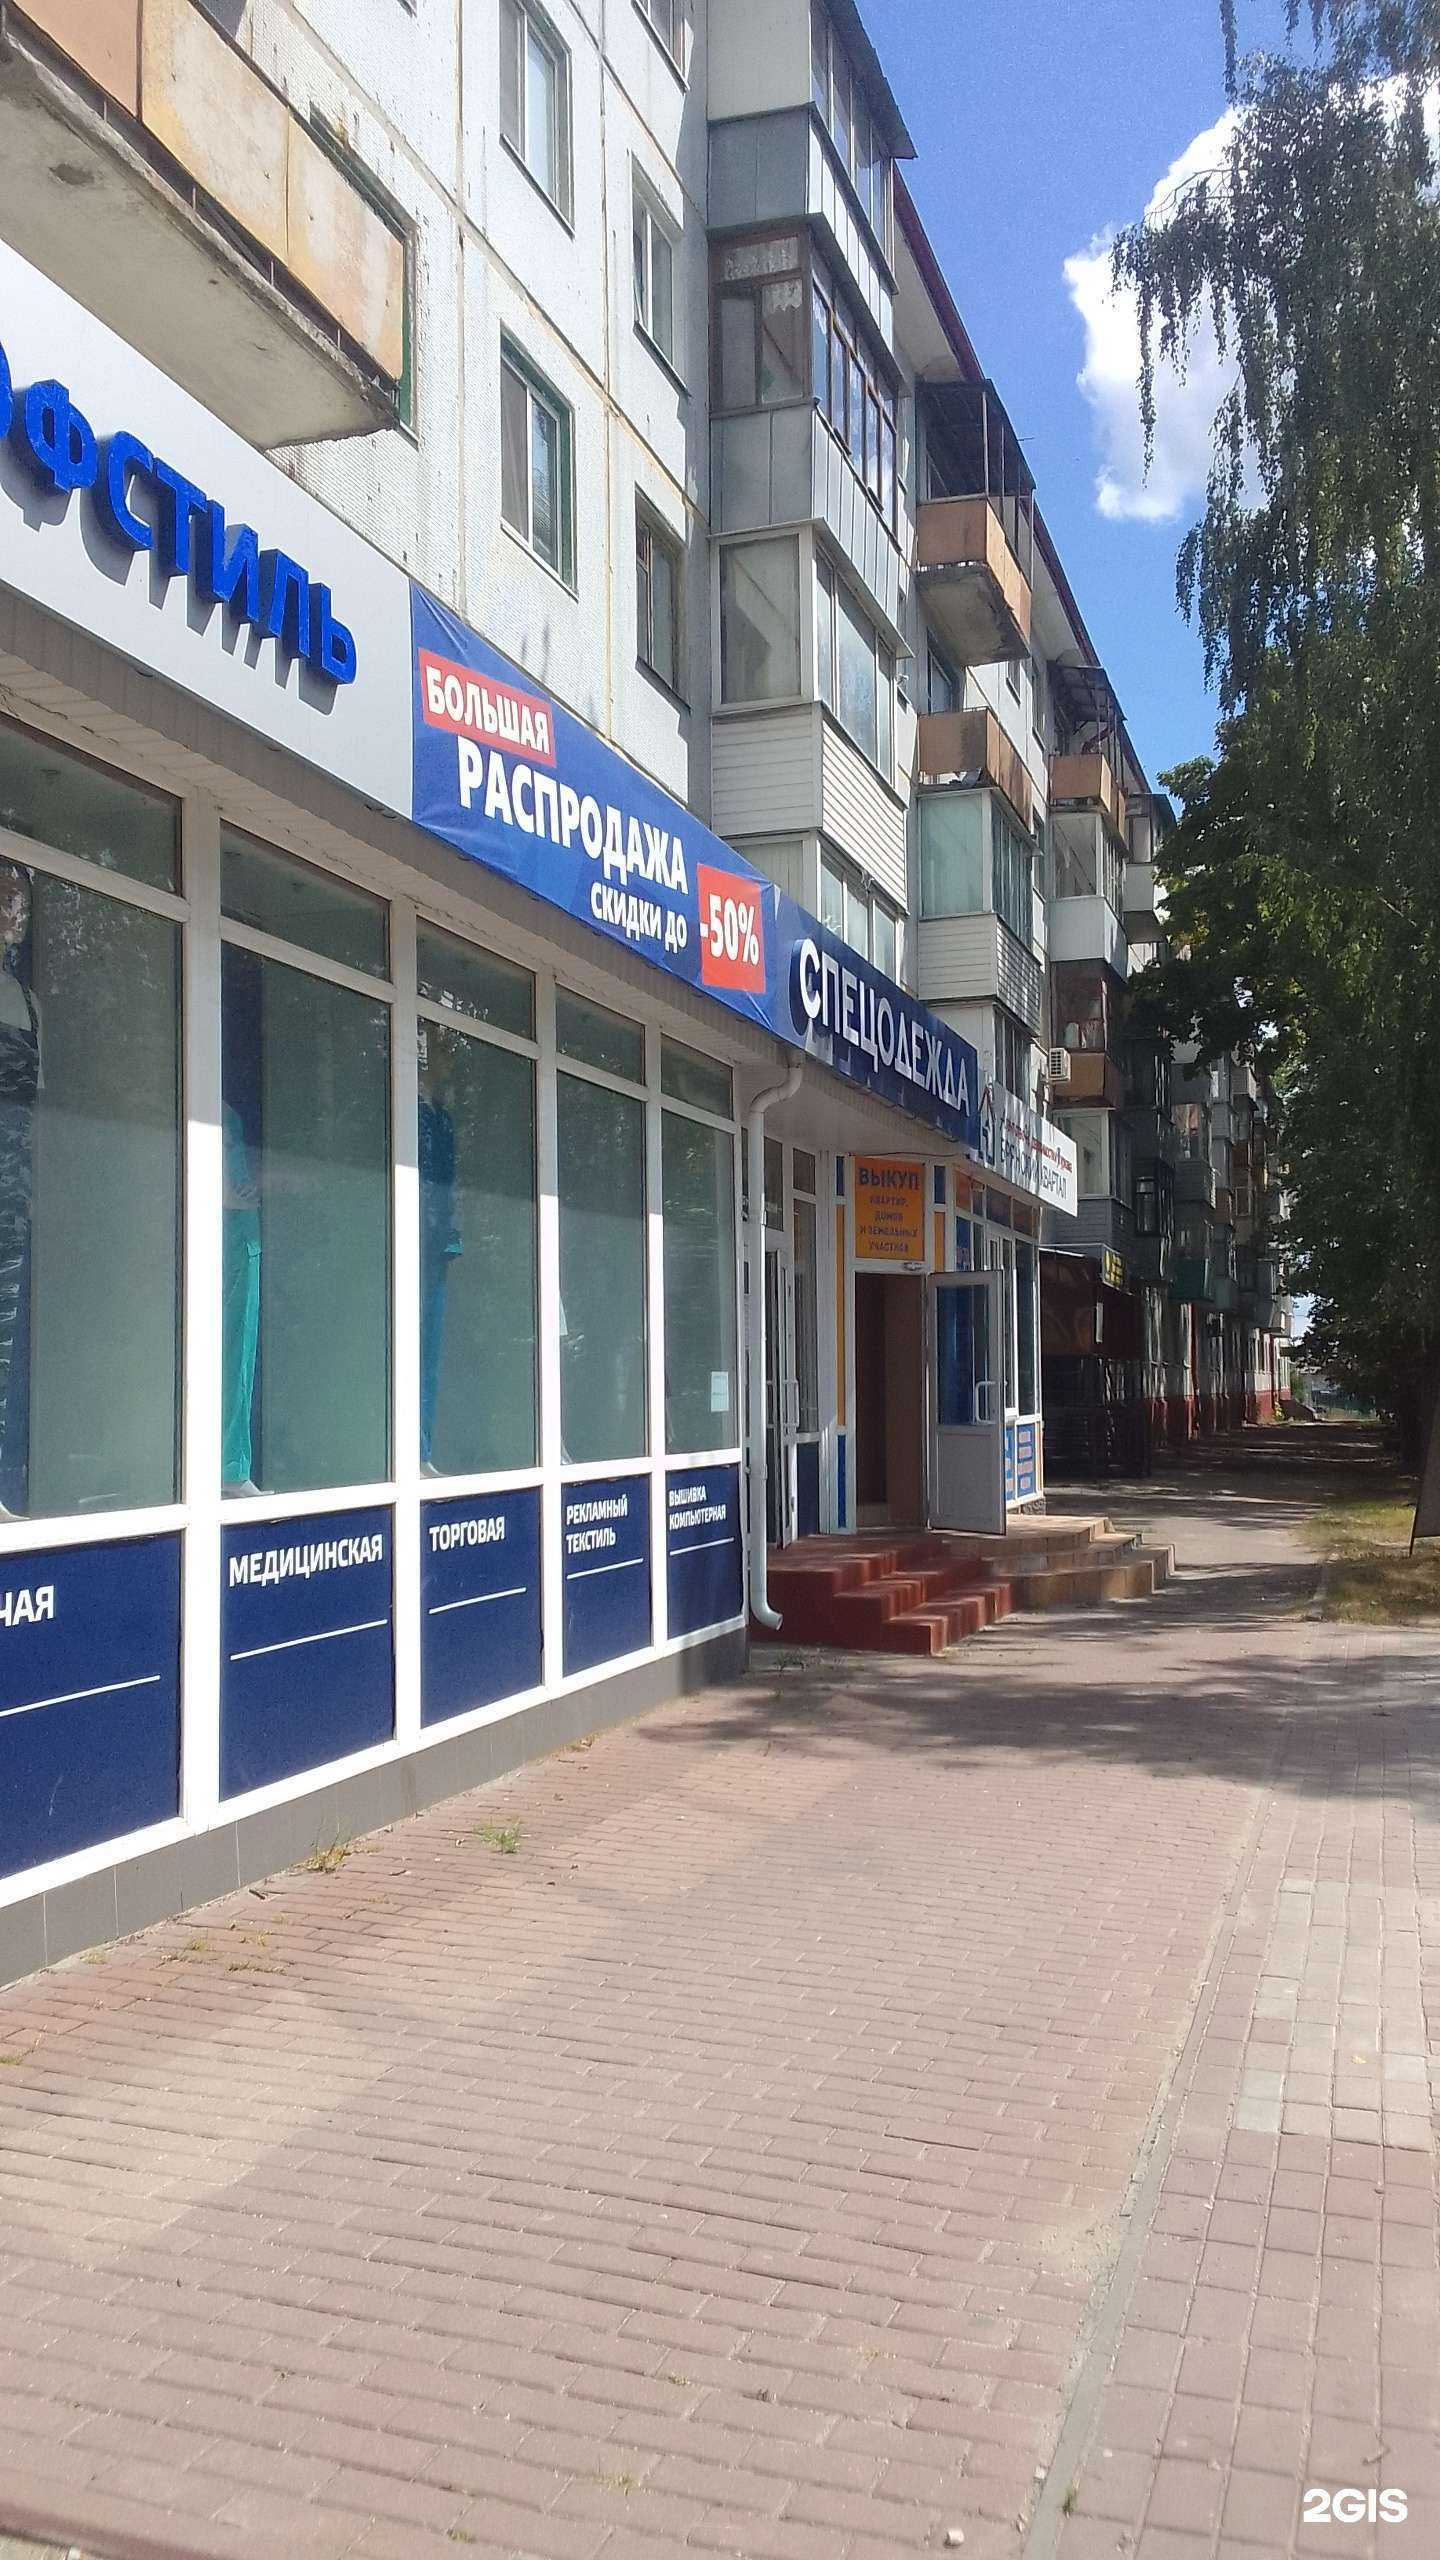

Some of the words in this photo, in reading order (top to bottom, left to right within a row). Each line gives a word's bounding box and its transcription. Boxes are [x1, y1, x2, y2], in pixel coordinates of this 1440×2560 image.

[0, 341, 358, 685] ФСТИЛЬ
[425, 664, 552, 755] БОЛЬШАЯ
[456, 735, 690, 896] РАСПРОДАЖА
[590, 881, 662, 942] СКИДКИ
[664, 907, 688, 954] ДО
[699, 894, 760, 966] -50%
[799, 937, 970, 1117] СПЕЦОДЕЖДА
[858, 1167, 919, 1190] ВЫКУП
[566, 1494, 628, 1525] РЕКЛАМНЫЙ
[669, 1485, 707, 1507] ВЫШИВКА
[669, 1504, 726, 1530] КОМПЬЮТЕРНАЯ
[429, 1516, 505, 1552] ТОРГОВАЯ
[566, 1527, 616, 1553] ТЕКСТИЛЬ
[229, 1534, 383, 1587] МЕДИЦИНСКАЯ
